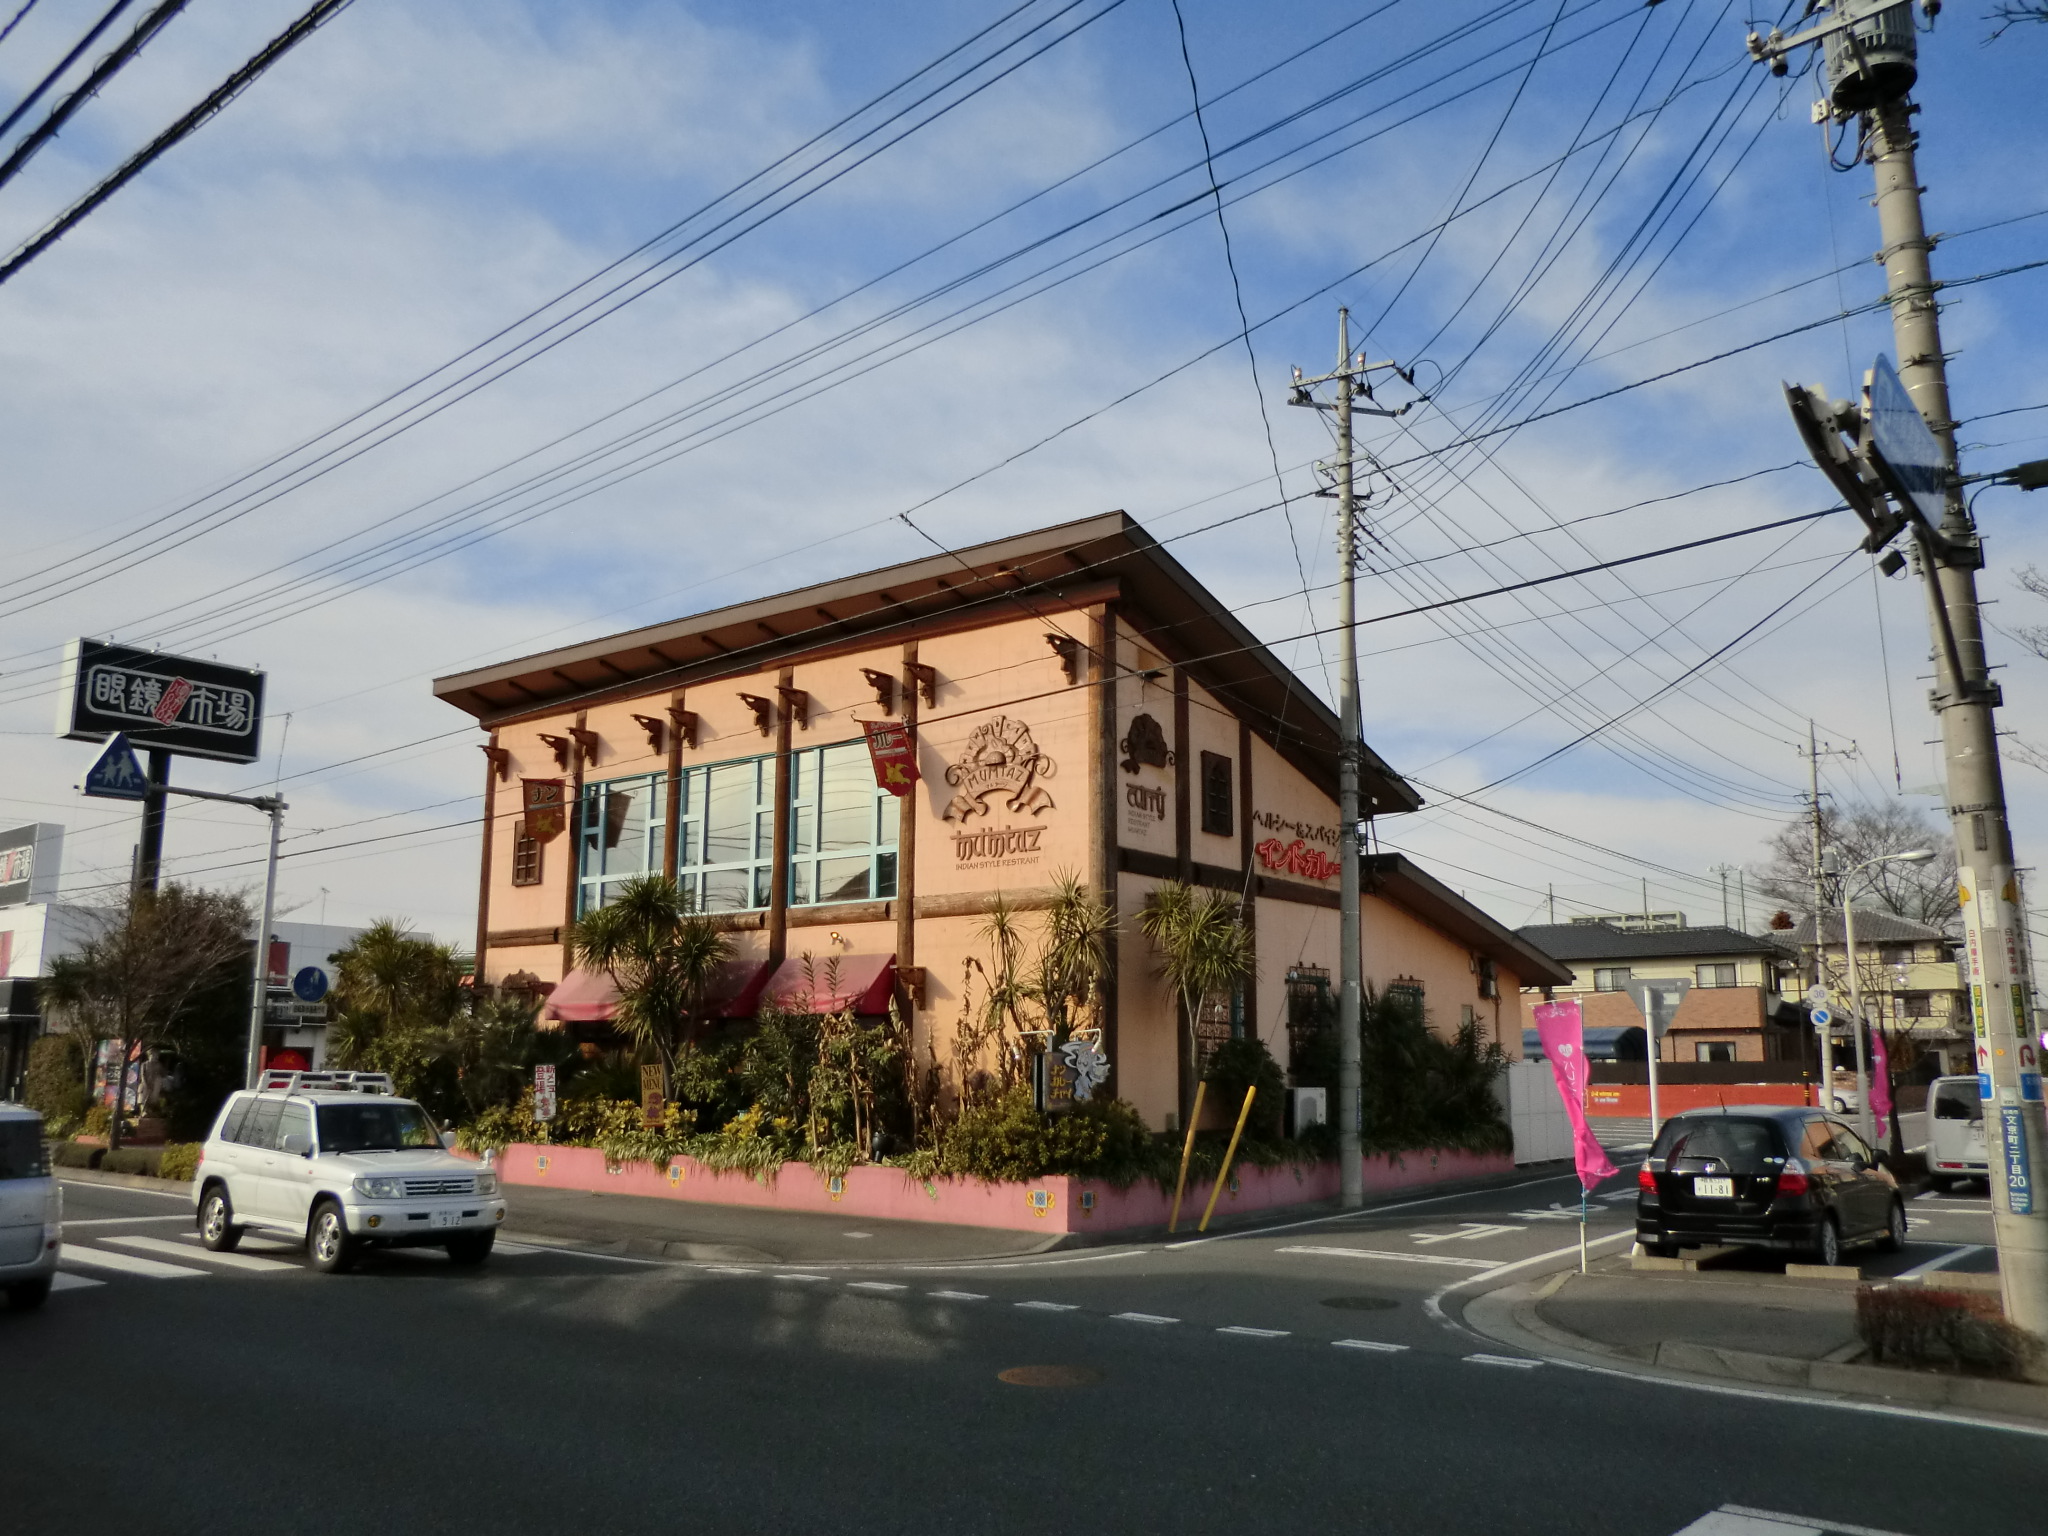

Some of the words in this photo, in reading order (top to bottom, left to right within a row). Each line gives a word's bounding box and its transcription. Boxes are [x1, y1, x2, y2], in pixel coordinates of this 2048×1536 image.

[95, 673, 247, 730] 眼鏡市場
[967, 766, 1025, 790] MUMTAZ
[531, 785, 559, 803] ナン
[1126, 783, 1167, 821] curry
[950, 825, 1048, 861] mumtaz
[955, 862, 979, 871] INDIAN
[979, 859, 1001, 869] STYLE
[1002, 856, 1040, 867] RESTRANT
[642, 1065, 661, 1077] NEW
[1051, 1064, 1067, 1076] ナン
[535, 1066, 546, 1094] 登場
[545, 1065, 556, 1099] 新メニュー
[642, 1078, 662, 1091] MENU
[1050, 1076, 1073, 1087] カレー
[1050, 1087, 1073, 1100] チャイ
[2006, 1115, 2022, 1175] 文京町二丁目
[1704, 1184, 1729, 1195] 11-81
[2009, 1175, 2026, 1188] 20
